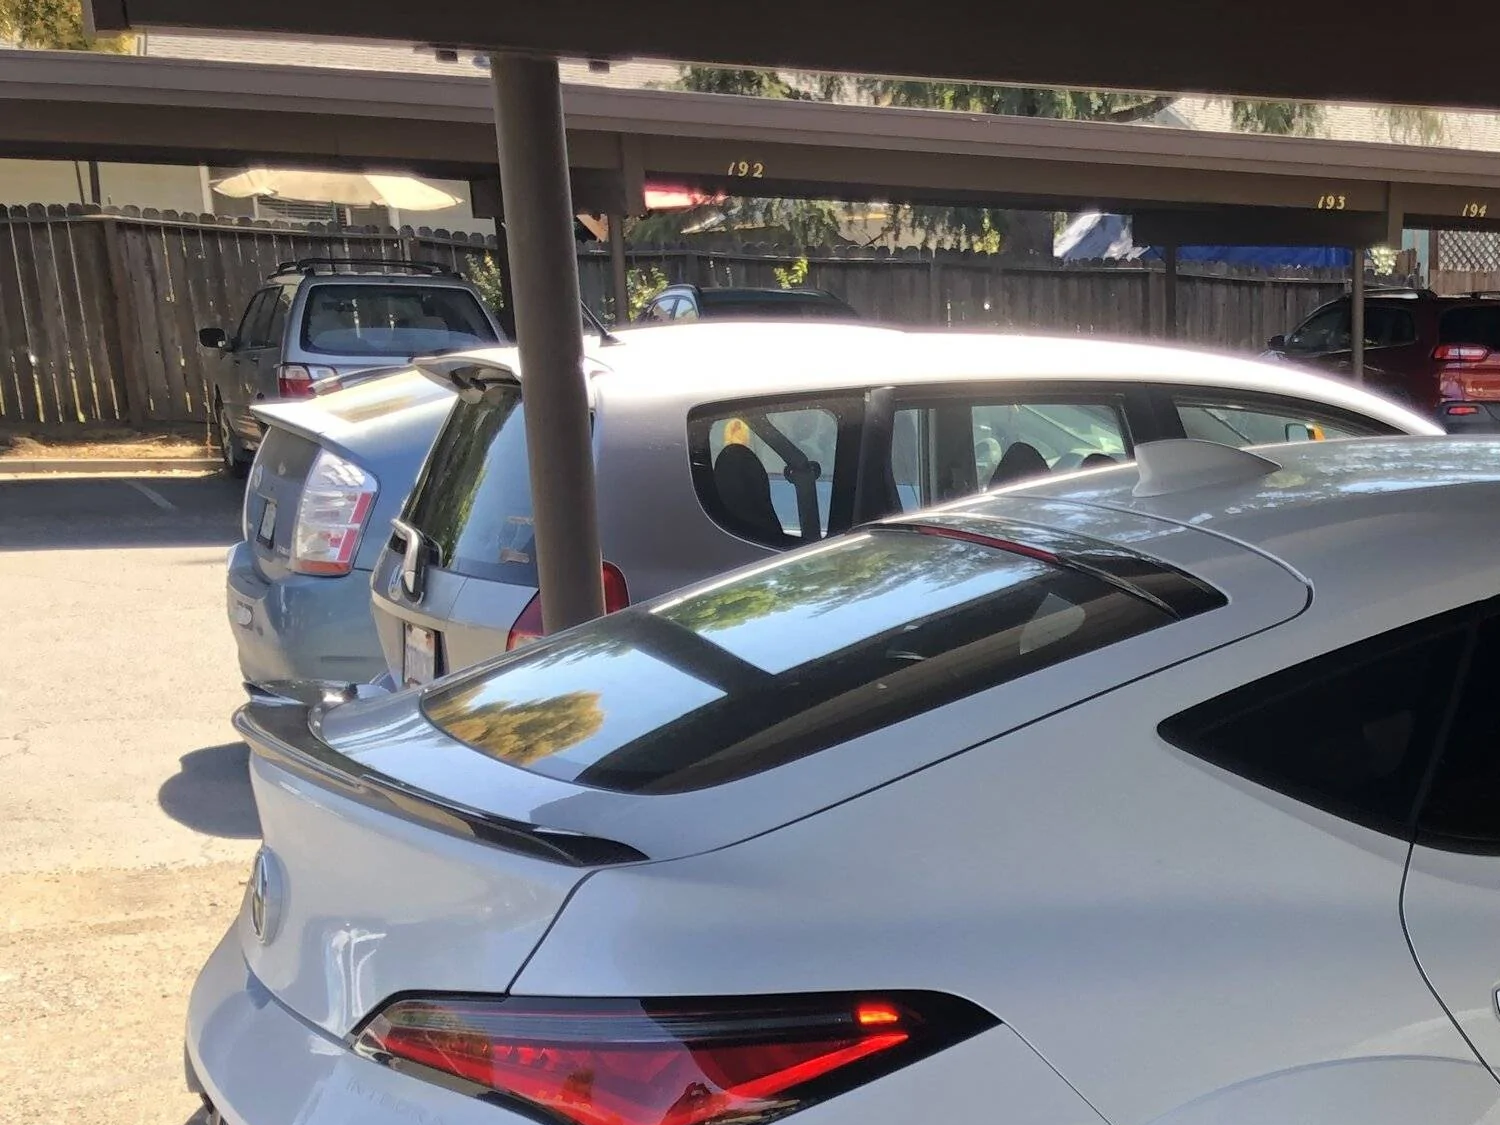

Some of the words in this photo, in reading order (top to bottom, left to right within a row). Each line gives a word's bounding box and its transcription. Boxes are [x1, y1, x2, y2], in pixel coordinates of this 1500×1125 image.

[727, 161, 763, 178] 192
[1317, 195, 1346, 210] 193
[1462, 203, 1488, 217] 194
